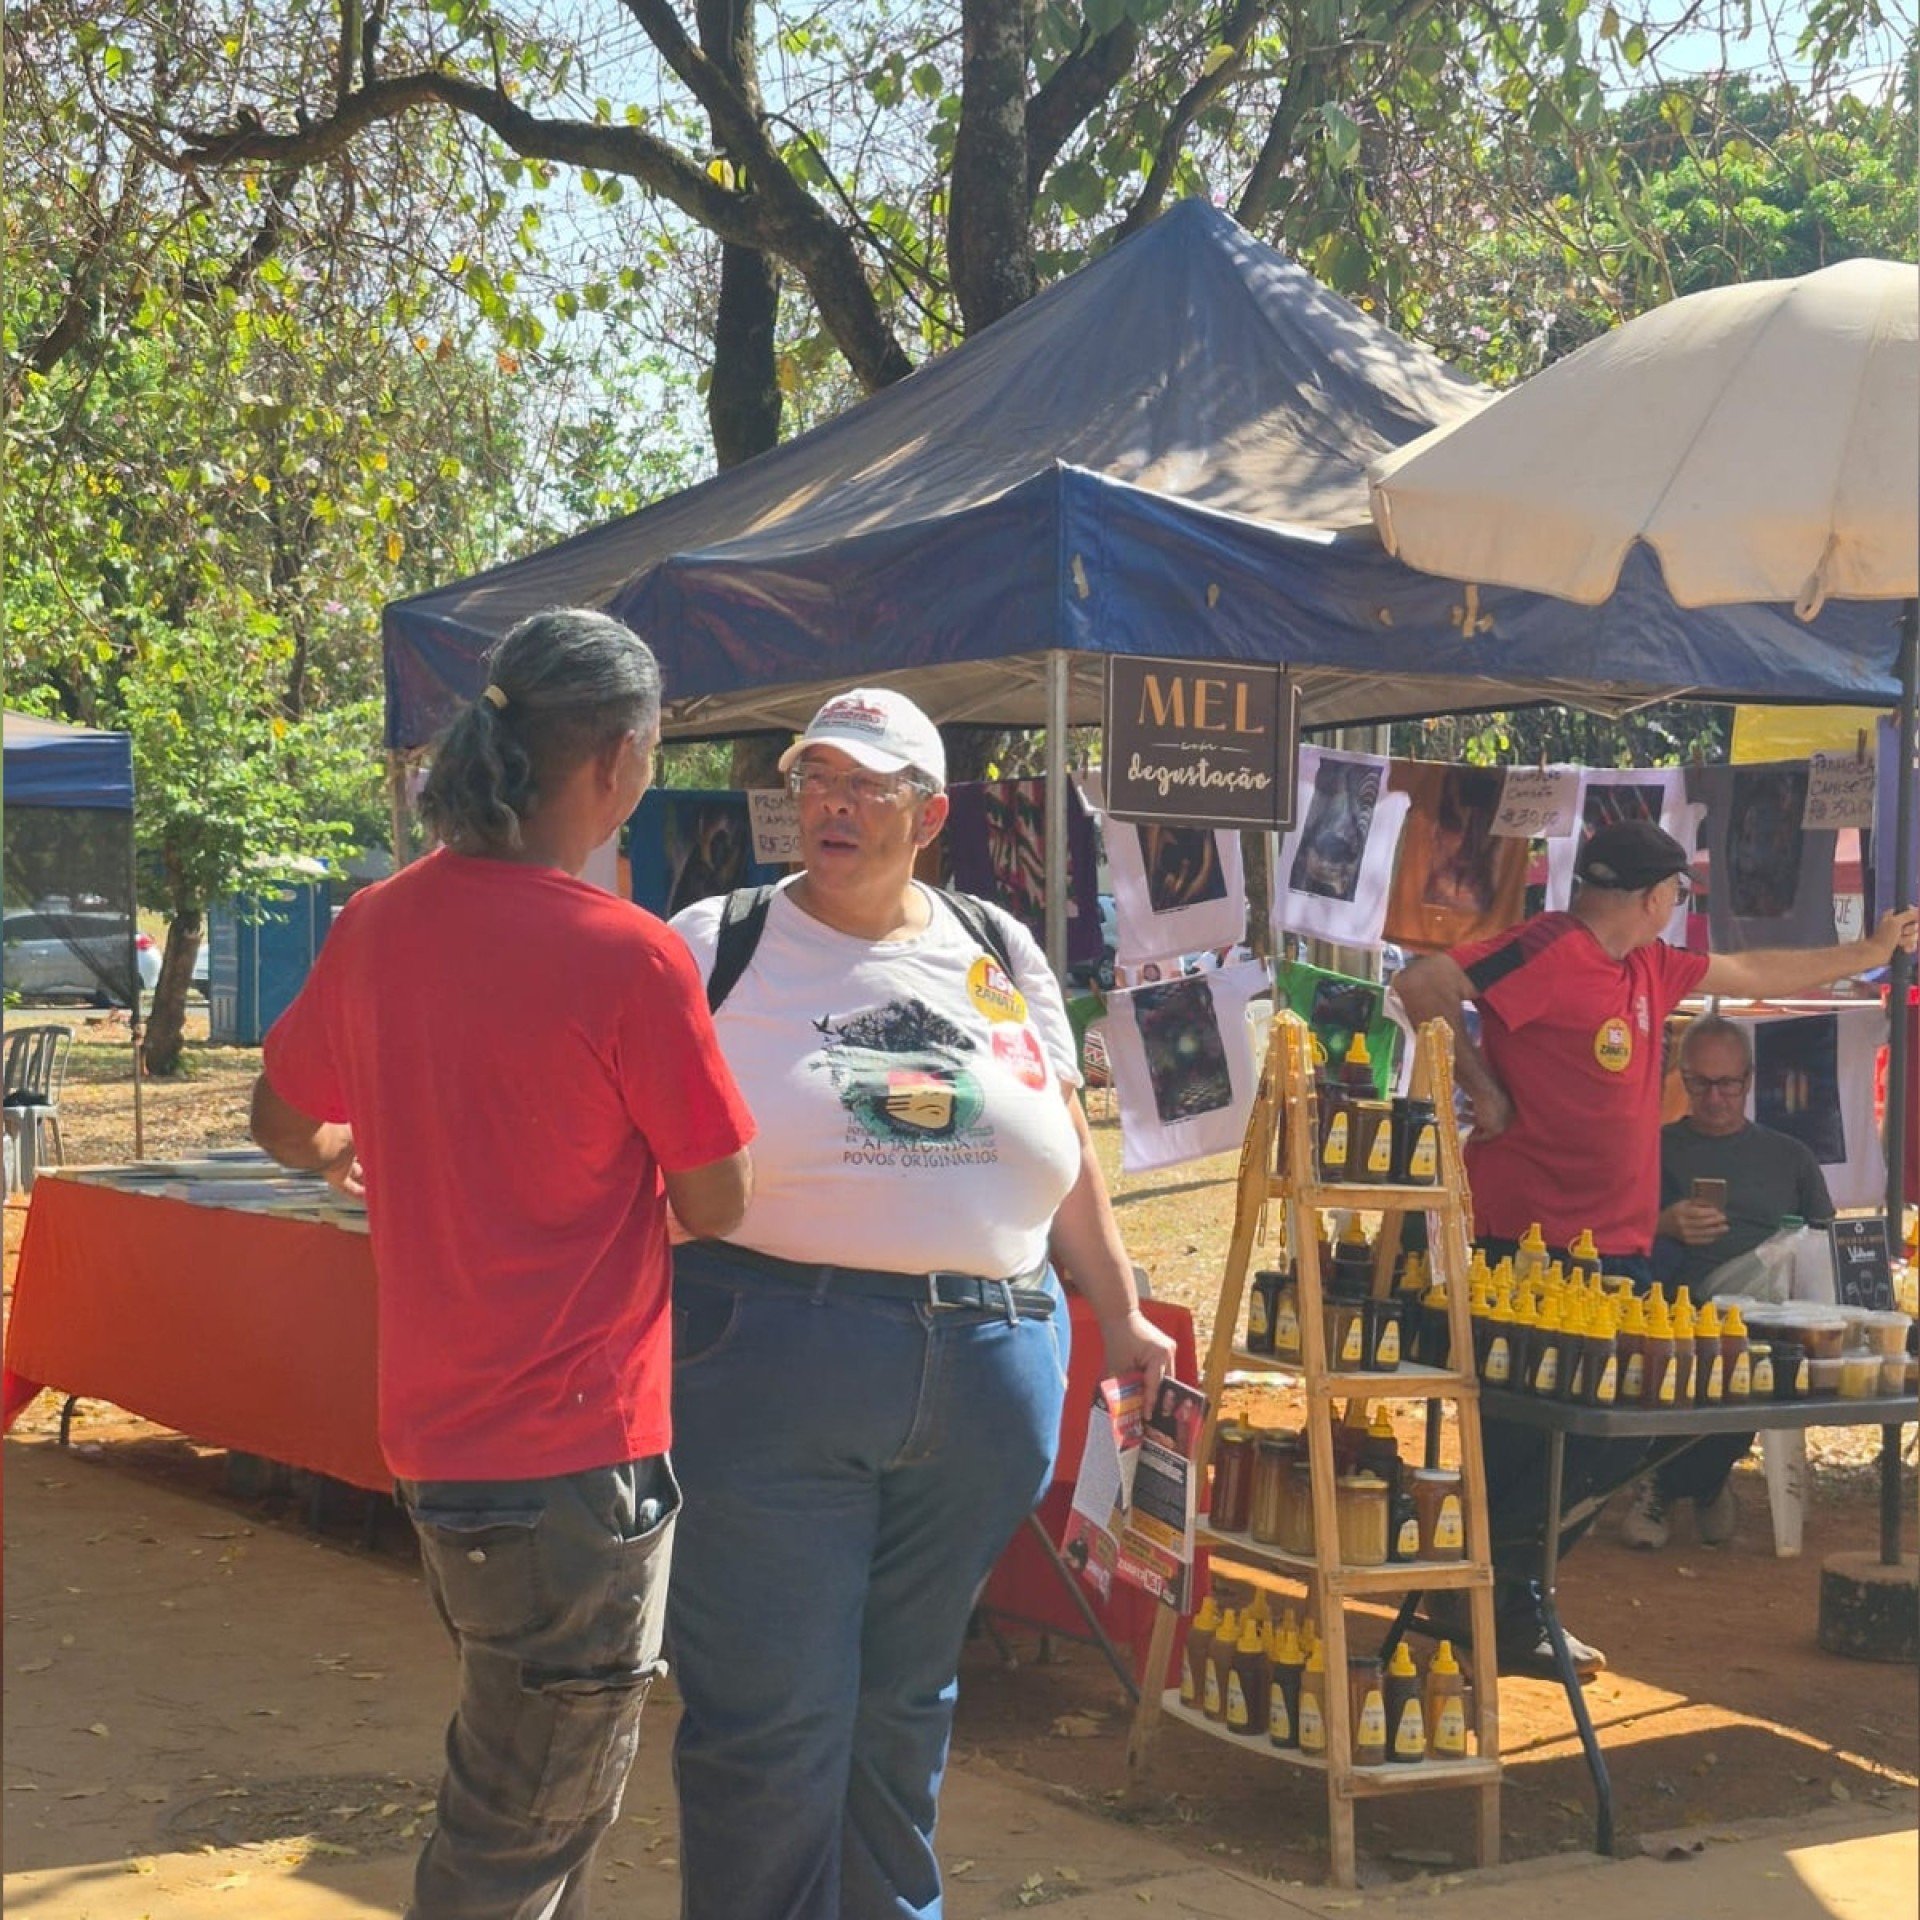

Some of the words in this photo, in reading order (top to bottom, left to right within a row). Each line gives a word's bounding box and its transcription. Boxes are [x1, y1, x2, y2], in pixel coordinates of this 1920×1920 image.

[1138, 674, 1265, 734] MEL
[1127, 752, 1271, 796] degustação
[842, 1151, 897, 1166] POVOS
